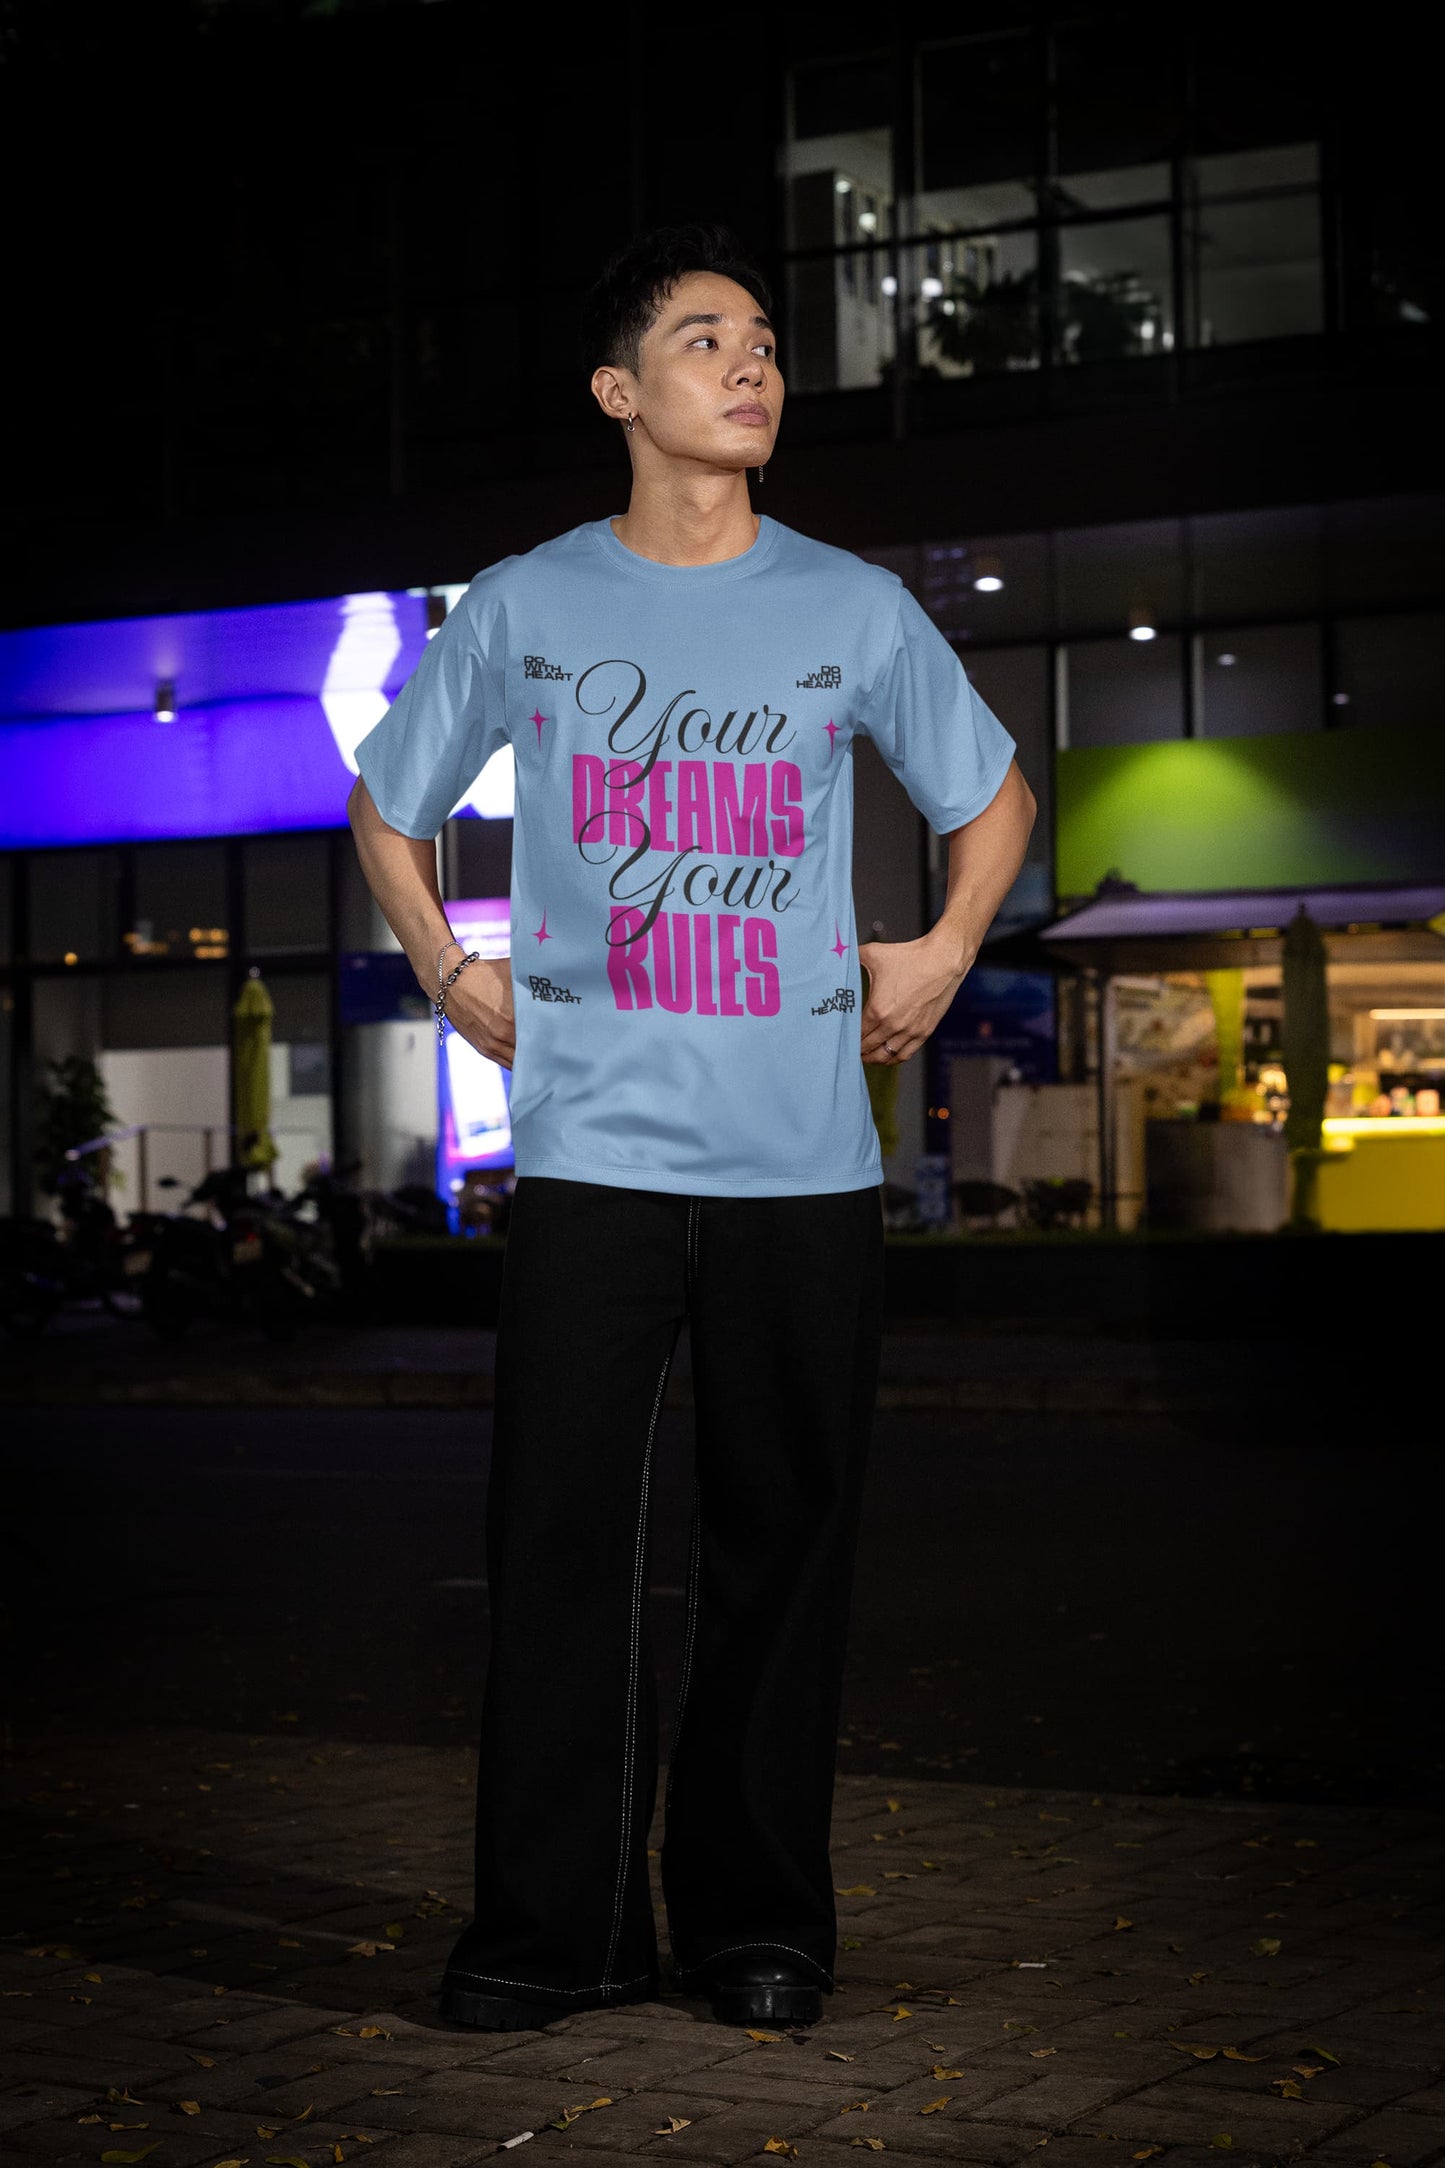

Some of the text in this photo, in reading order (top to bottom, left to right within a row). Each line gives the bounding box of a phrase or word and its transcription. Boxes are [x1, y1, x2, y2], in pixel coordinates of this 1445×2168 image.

[524, 655, 545, 664] DO
[525, 662, 561, 673] WITH
[821, 665, 841, 674] DO
[525, 670, 573, 681] HEART
[807, 672, 841, 683] WITH
[796, 680, 841, 689] HEART
[575, 659, 797, 789] Your
[573, 753, 805, 857] DREAMS
[578, 811, 801, 947] Your
[606, 905, 781, 1017] RULES
[529, 975, 551, 986] DO
[530, 984, 570, 997] WITH
[836, 988, 854, 997] DO
[532, 991, 582, 1004] HEART
[822, 995, 855, 1007] WITH
[811, 1003, 855, 1015] HEART
